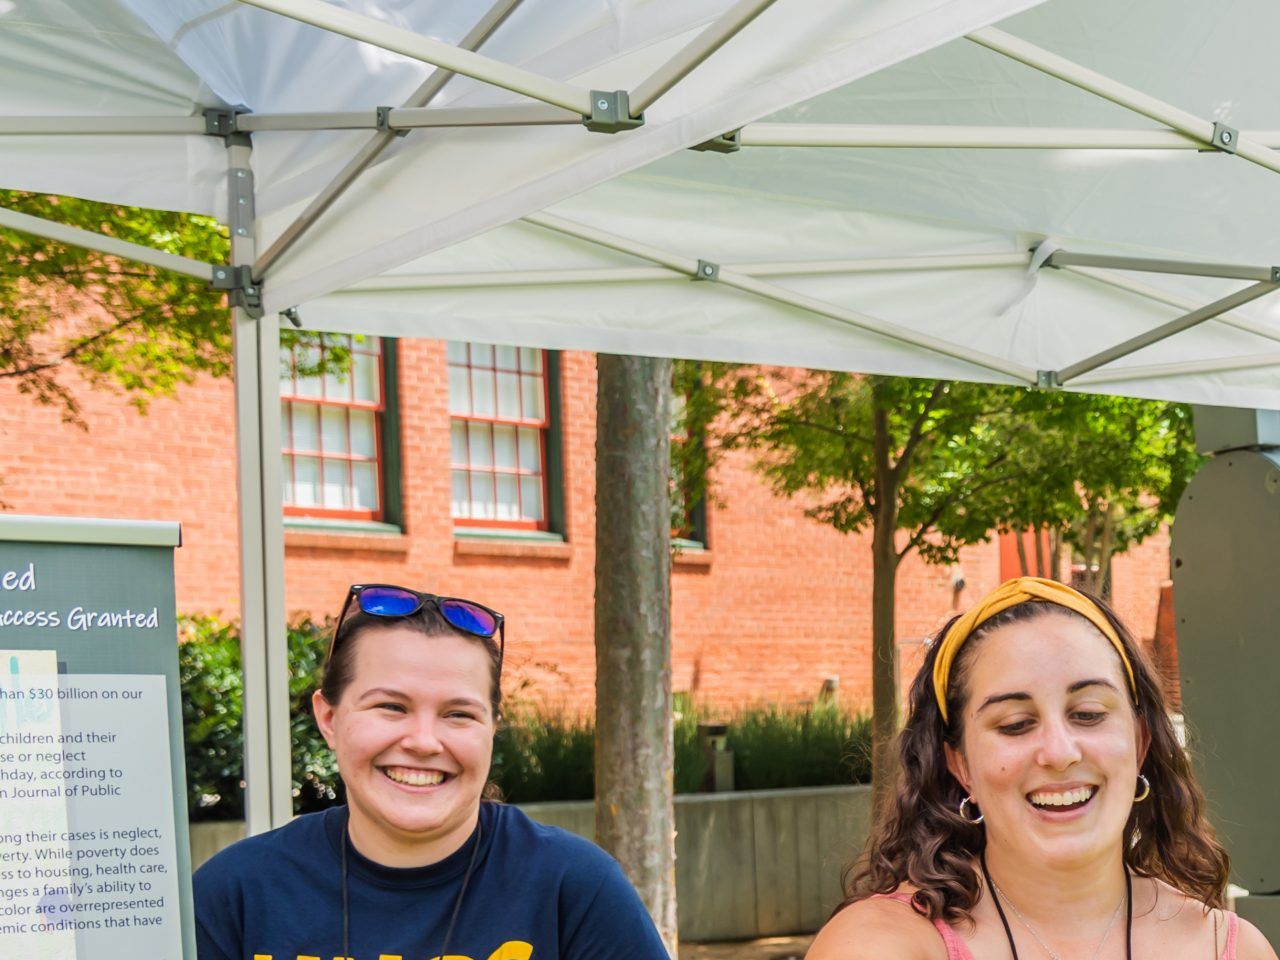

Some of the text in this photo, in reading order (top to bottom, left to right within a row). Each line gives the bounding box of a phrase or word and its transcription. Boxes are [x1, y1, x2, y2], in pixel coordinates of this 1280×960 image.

[0, 562, 36, 591] ed
[67, 606, 159, 631] Granted
[29, 687, 54, 700] $30
[57, 687, 98, 700] billion
[101, 690, 119, 700] on
[121, 690, 144, 700] our
[0, 732, 117, 745] children and their
[18, 753, 33, 762] or
[36, 749, 87, 764] neglect
[40, 767, 107, 781] according
[109, 768, 123, 779] to
[11, 785, 61, 799] Journal
[64, 784, 79, 798] of
[81, 783, 122, 797] Public
[26, 830, 57, 843] their
[60, 831, 97, 841] cases
[99, 828, 109, 840] is
[112, 827, 163, 842] neglect,
[34, 847, 74, 860] While
[76, 847, 127, 862] poverty
[130, 845, 160, 856] does
[18, 869, 32, 879] to
[35, 865, 93, 879] housing,
[96, 862, 137, 875] health
[139, 863, 168, 874] care,
[32, 887, 40, 896] a
[96, 880, 136, 894] ability
[139, 881, 152, 891] to
[35, 904, 57, 914] are
[59, 896, 165, 913] overrepresented
[30, 916, 102, 932] conditions
[104, 916, 131, 928] that
[133, 914, 164, 926] have
